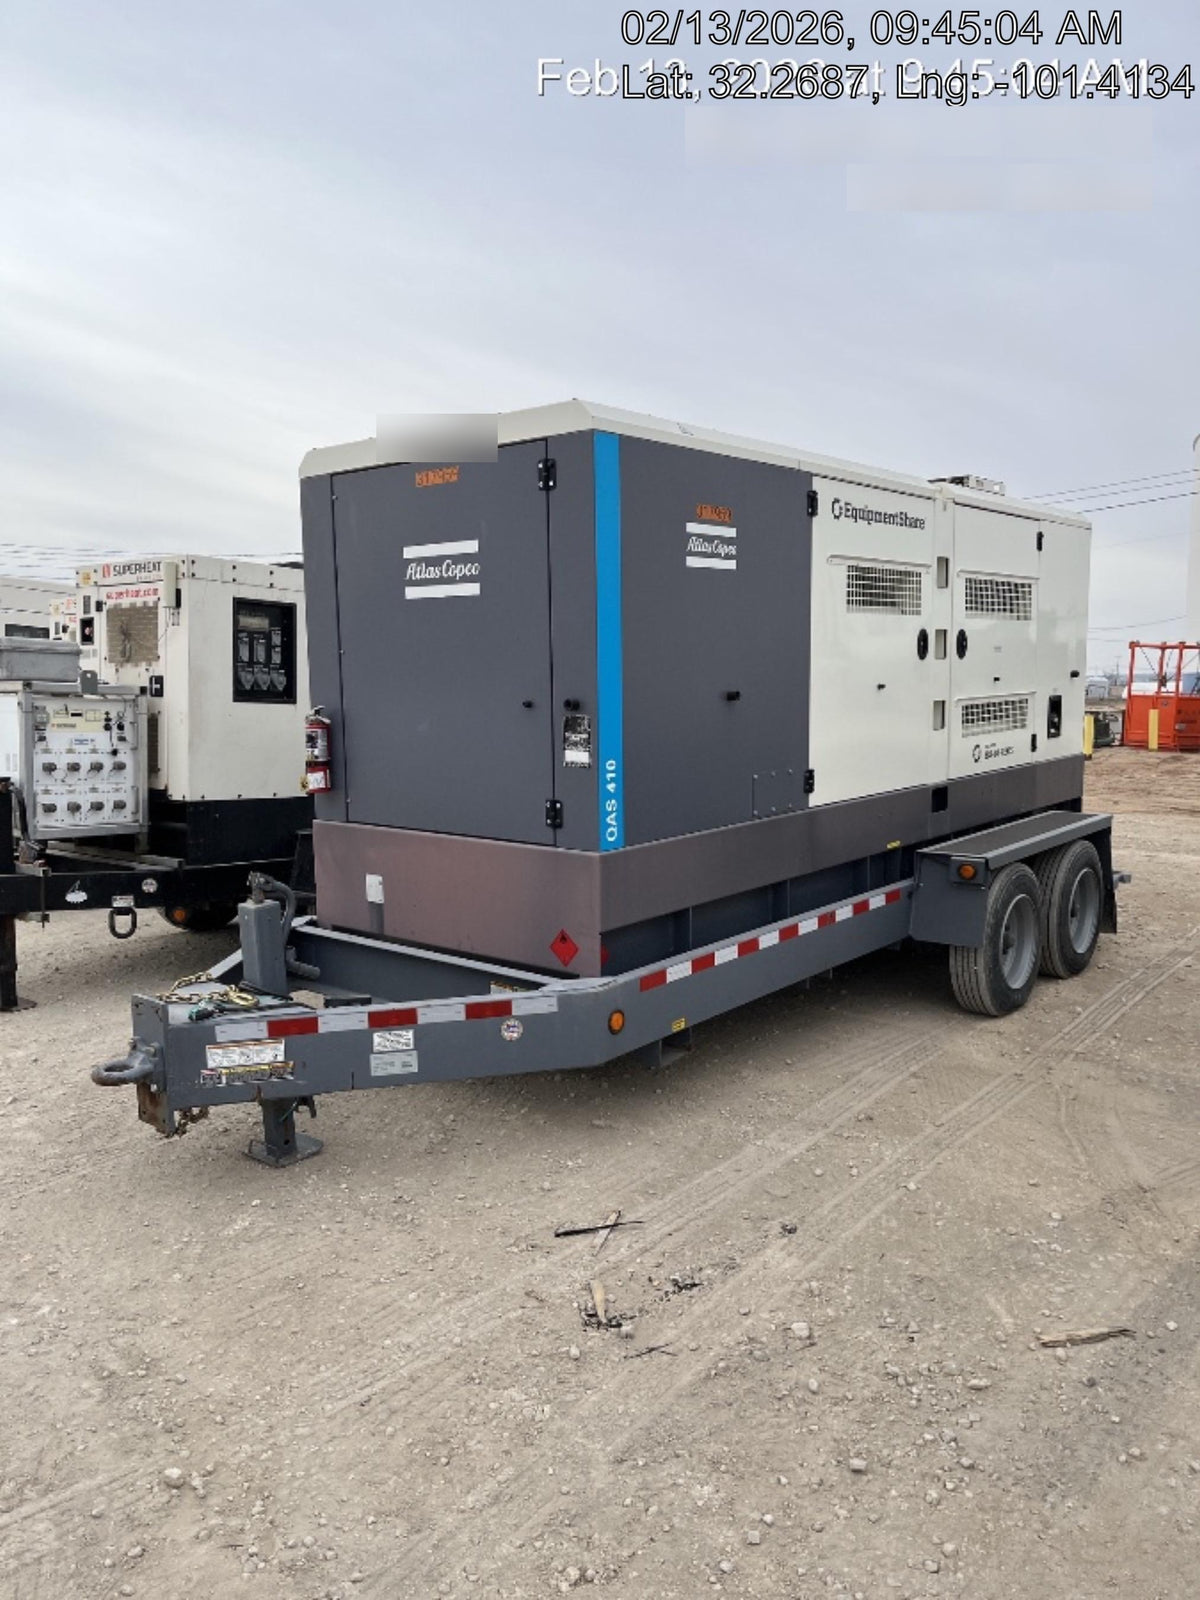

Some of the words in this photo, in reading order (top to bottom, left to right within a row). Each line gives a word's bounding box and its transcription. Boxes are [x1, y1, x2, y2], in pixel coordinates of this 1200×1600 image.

[844, 501, 926, 530] EquipmentShare
[113, 561, 162, 577] SUPERHEAT
[405, 561, 441, 580] Atlas
[442, 559, 481, 580] Copco
[605, 759, 617, 793] 410
[605, 799, 618, 842] QAS
